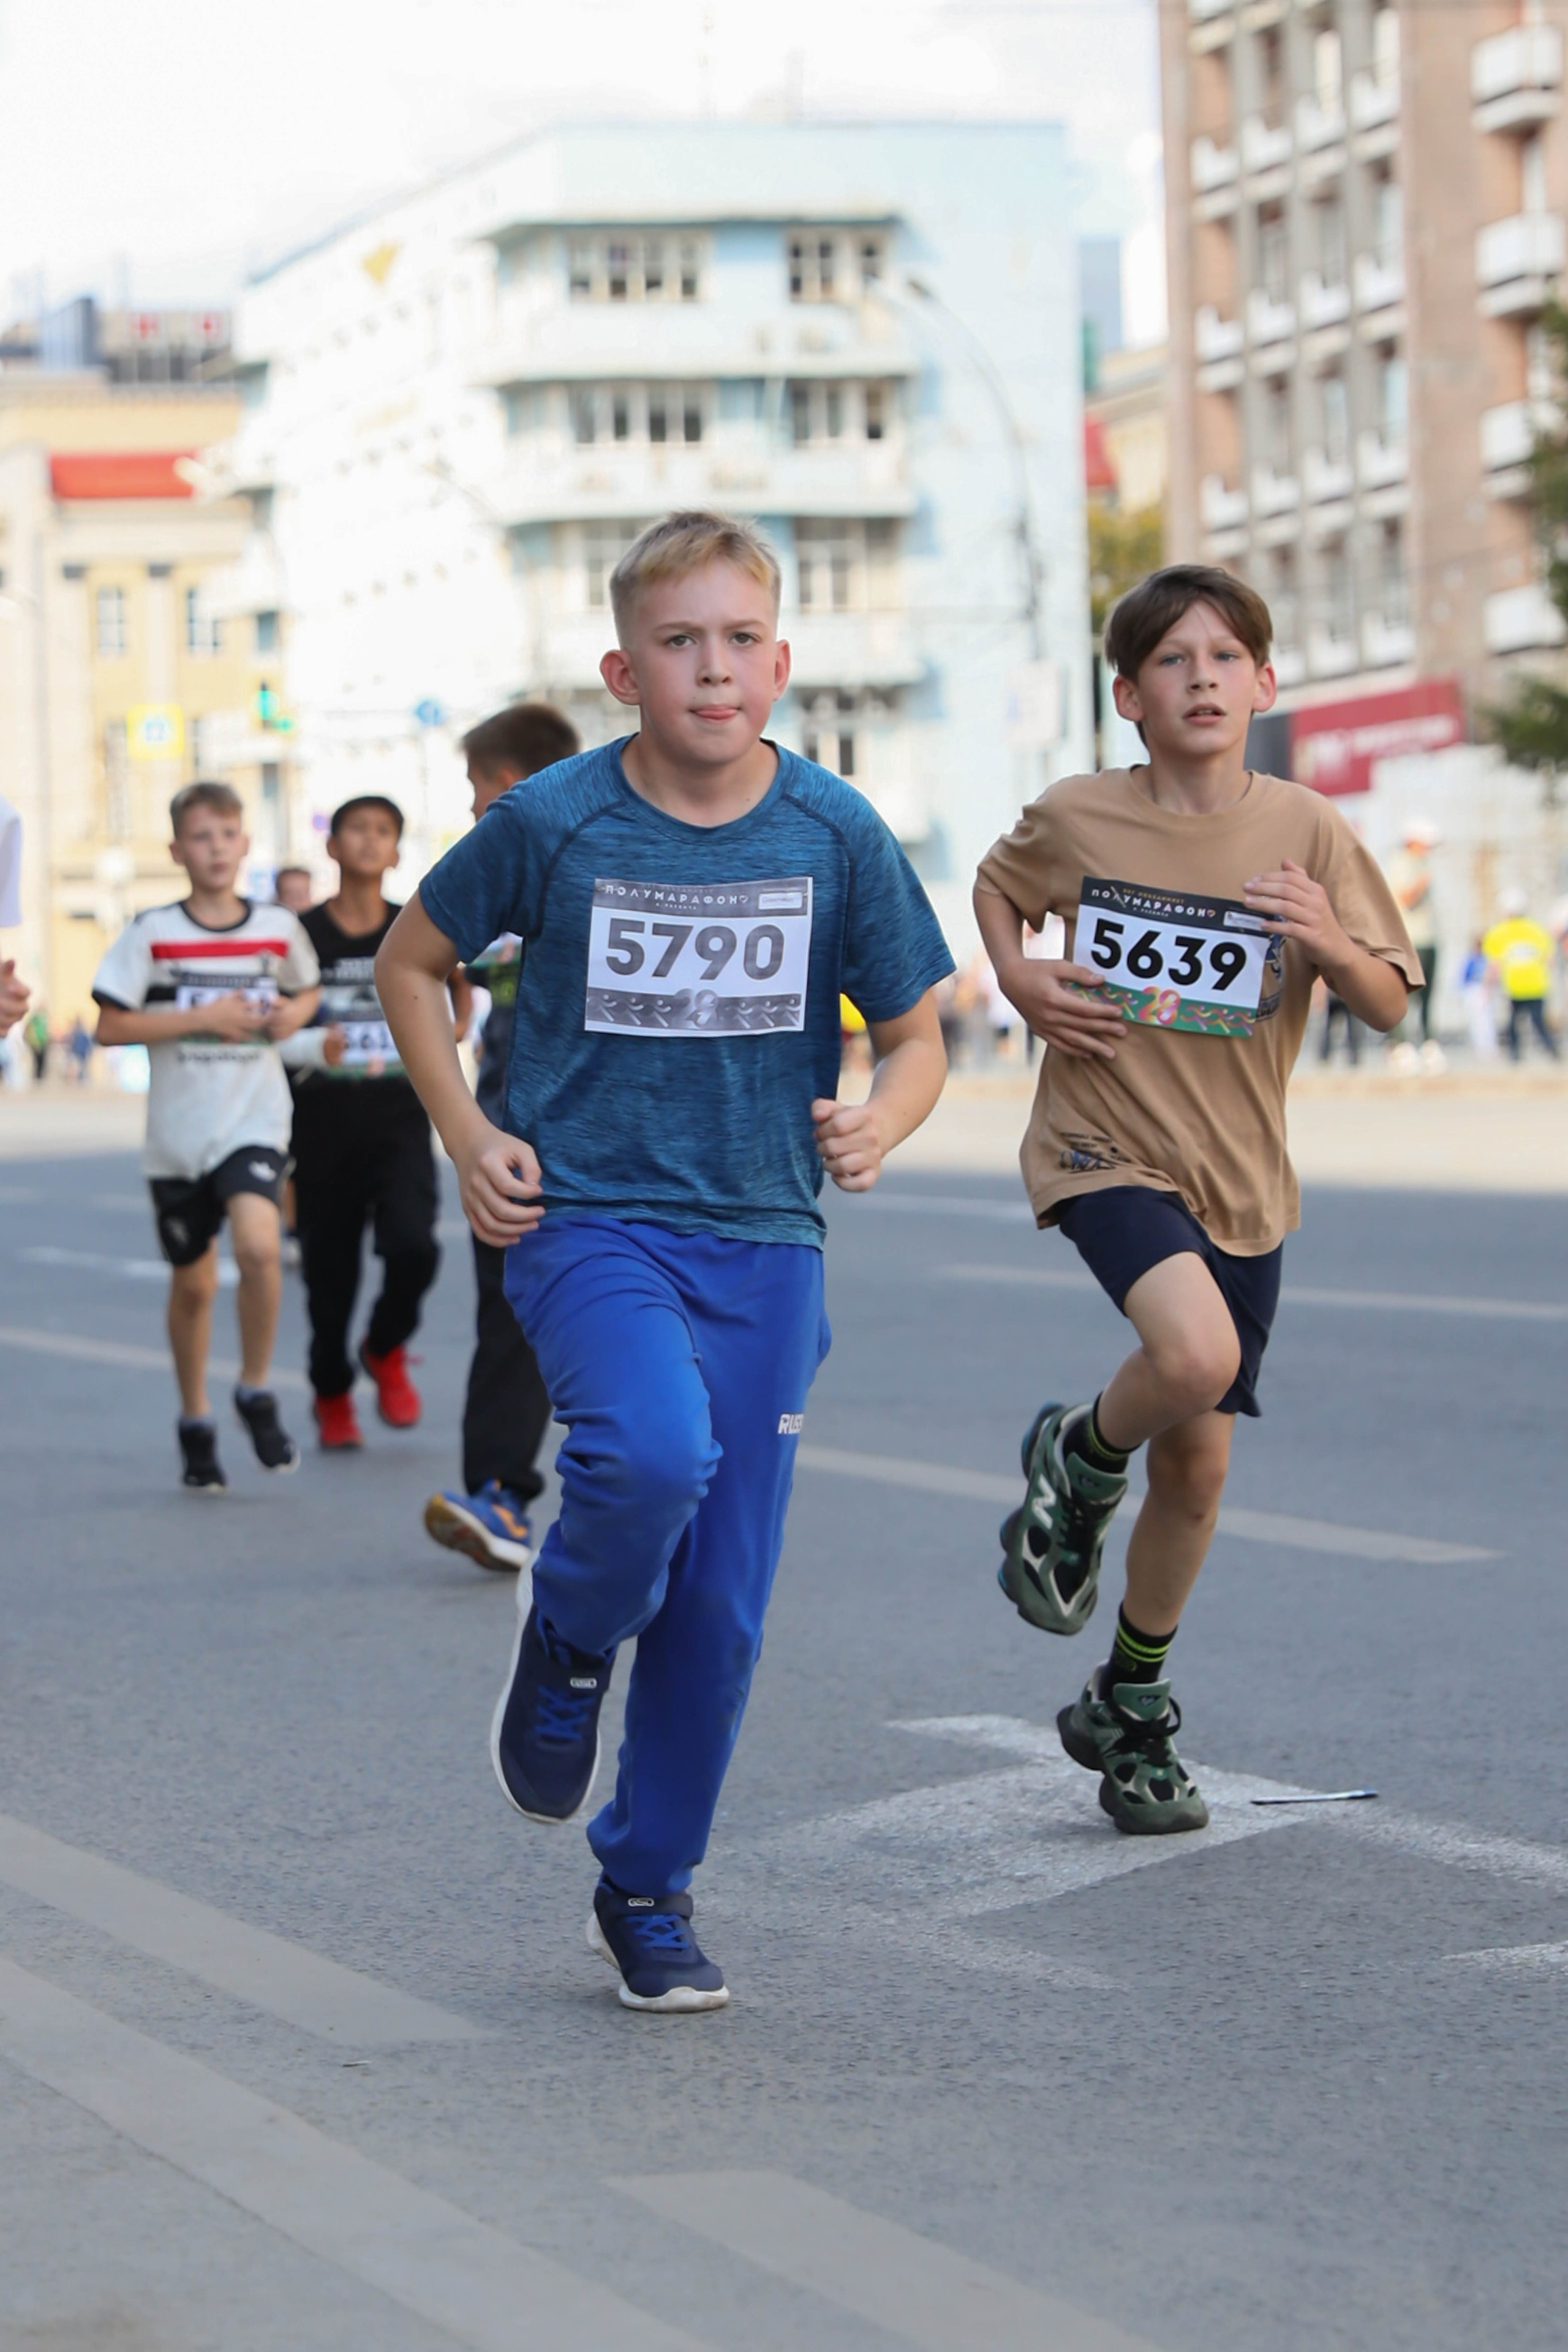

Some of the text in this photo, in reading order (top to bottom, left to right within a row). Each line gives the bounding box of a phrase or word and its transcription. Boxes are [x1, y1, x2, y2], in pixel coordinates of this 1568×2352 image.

[605, 885, 737, 904] ПОЛУМАРАФОН
[1091, 889, 1206, 918] ПОЛУМАРАФОН
[606, 918, 785, 980] 5790
[1091, 918, 1246, 991] 5639
[1138, 986, 1180, 1025] 28
